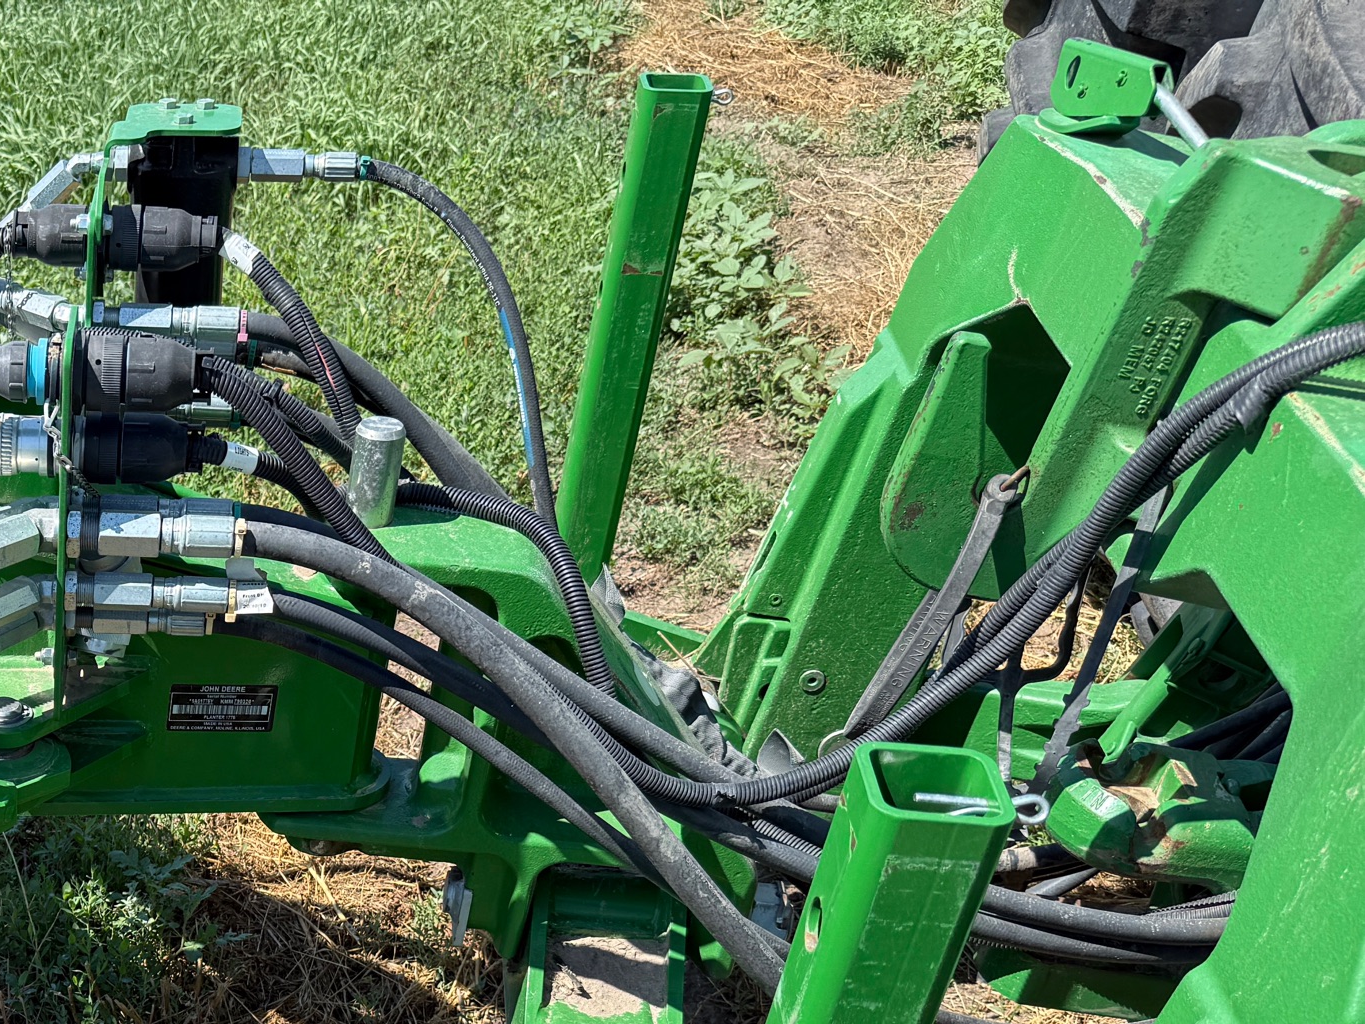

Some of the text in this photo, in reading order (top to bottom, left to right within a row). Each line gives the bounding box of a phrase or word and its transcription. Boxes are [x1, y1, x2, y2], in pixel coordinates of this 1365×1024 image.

[1118, 344, 1144, 379] MEM
[892, 610, 950, 688] WARNING
[221, 685, 247, 693] DEERE
